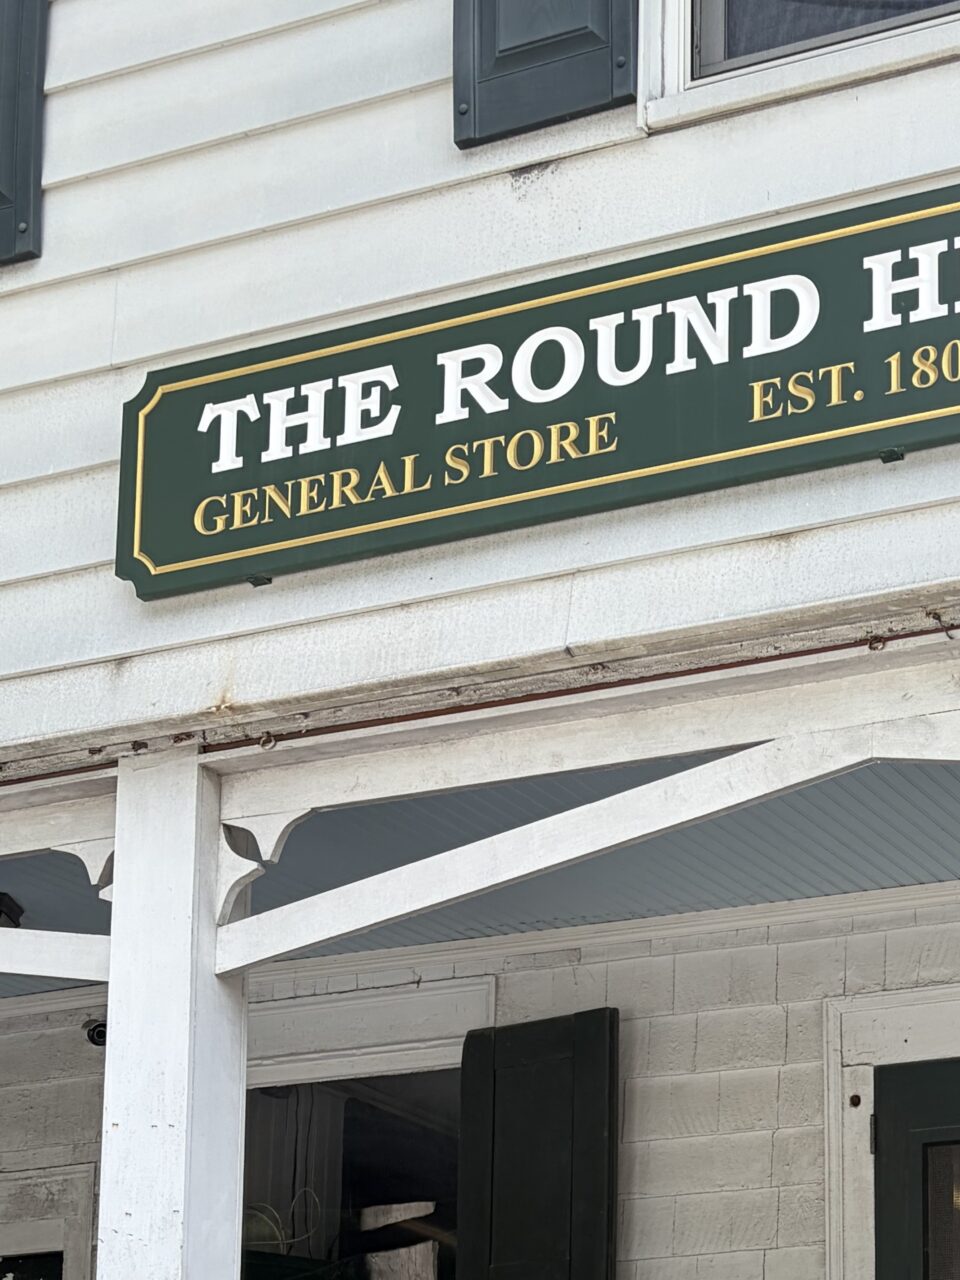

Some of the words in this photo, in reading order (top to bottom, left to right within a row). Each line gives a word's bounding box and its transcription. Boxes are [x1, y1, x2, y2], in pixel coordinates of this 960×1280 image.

[197, 364, 402, 474] THE
[434, 274, 822, 426] ROUND
[749, 361, 865, 423] EST.
[192, 453, 432, 536] GENERAL
[444, 412, 619, 487] STORE
